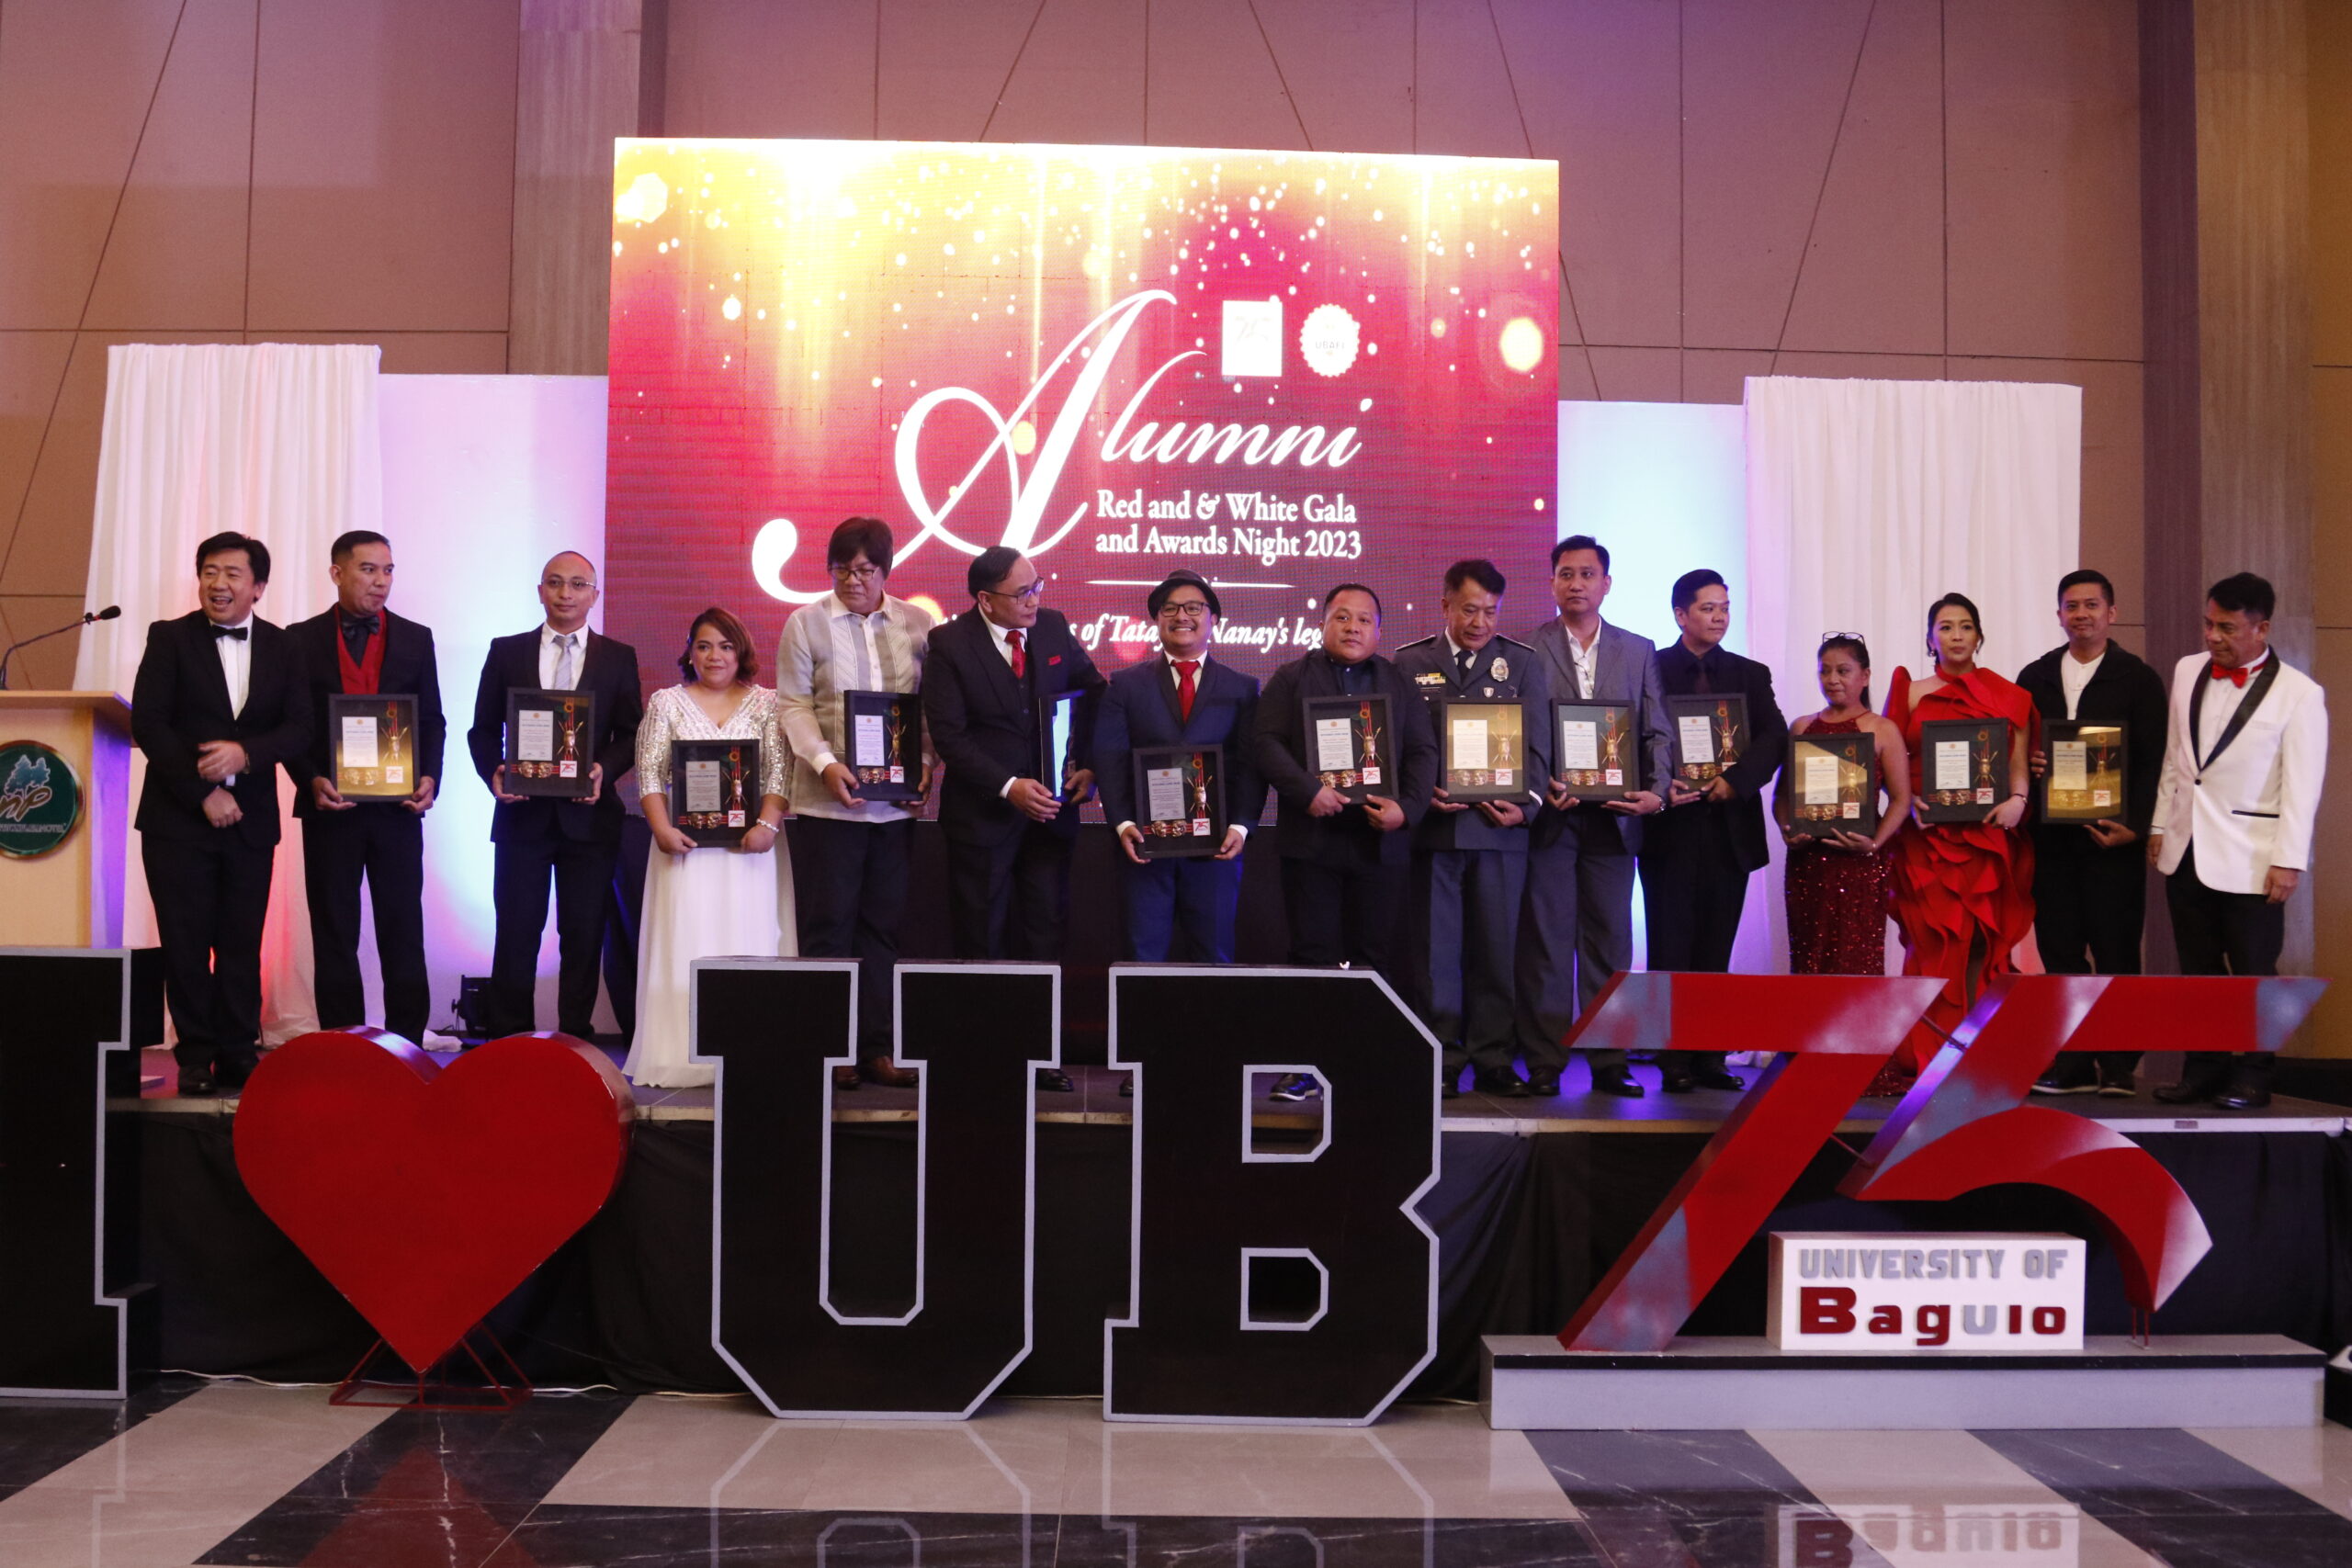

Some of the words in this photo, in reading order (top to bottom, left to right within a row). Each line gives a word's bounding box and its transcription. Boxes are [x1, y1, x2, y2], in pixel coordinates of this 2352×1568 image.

[752, 289, 1372, 604] Alumni
[1096, 488, 1143, 519] Red
[1148, 490, 1192, 520] and
[1196, 492, 1221, 521] &
[1225, 491, 1299, 522] White
[1303, 493, 1358, 524] Gala
[1095, 524, 1139, 553] and
[1142, 525, 1228, 556] Awards
[1231, 526, 1301, 567] Night
[1304, 529, 1363, 559] 2023
[1080, 613, 1110, 651] of
[1206, 616, 1289, 654] Nanay's
[1557, 971, 2332, 1353] 75
[1798, 1248, 2006, 1280] UNIVERSITY
[2023, 1248, 2069, 1280] OF
